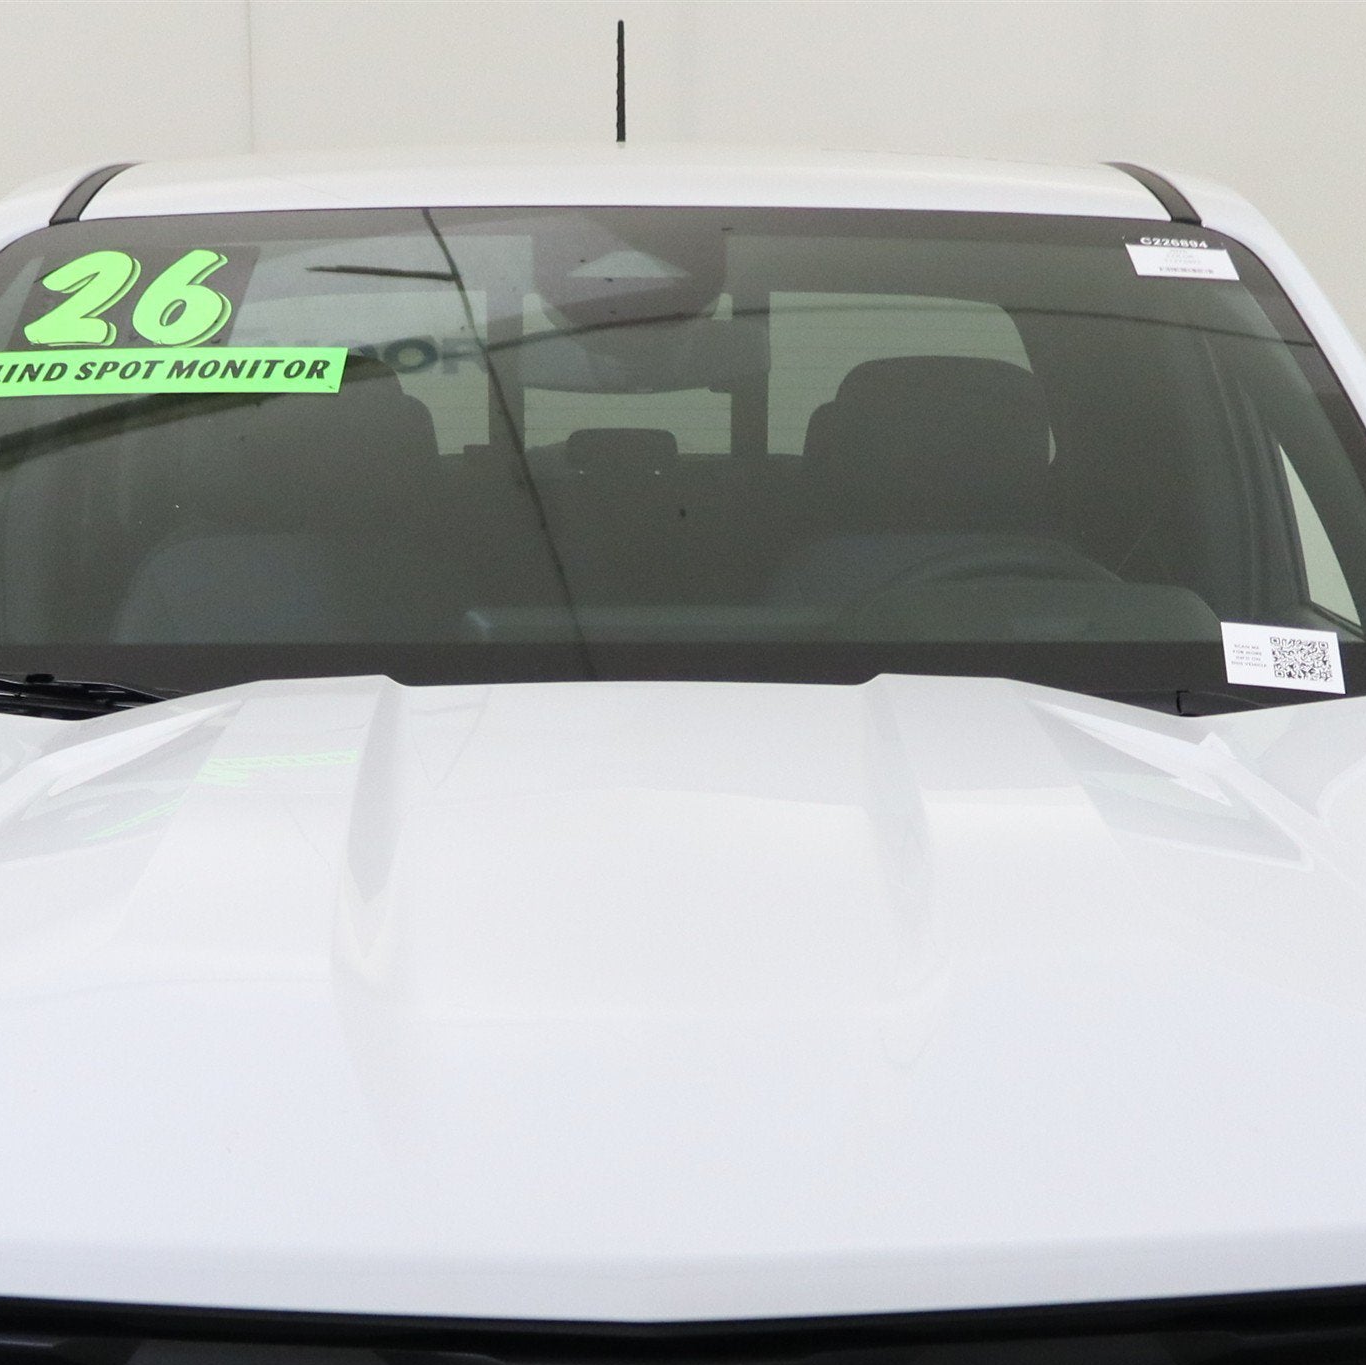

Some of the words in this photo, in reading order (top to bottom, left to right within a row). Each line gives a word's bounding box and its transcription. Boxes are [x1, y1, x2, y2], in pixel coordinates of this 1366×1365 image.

[23, 249, 232, 347] 26
[73, 359, 165, 381] SPOT
[167, 357, 332, 380] MONITOR
